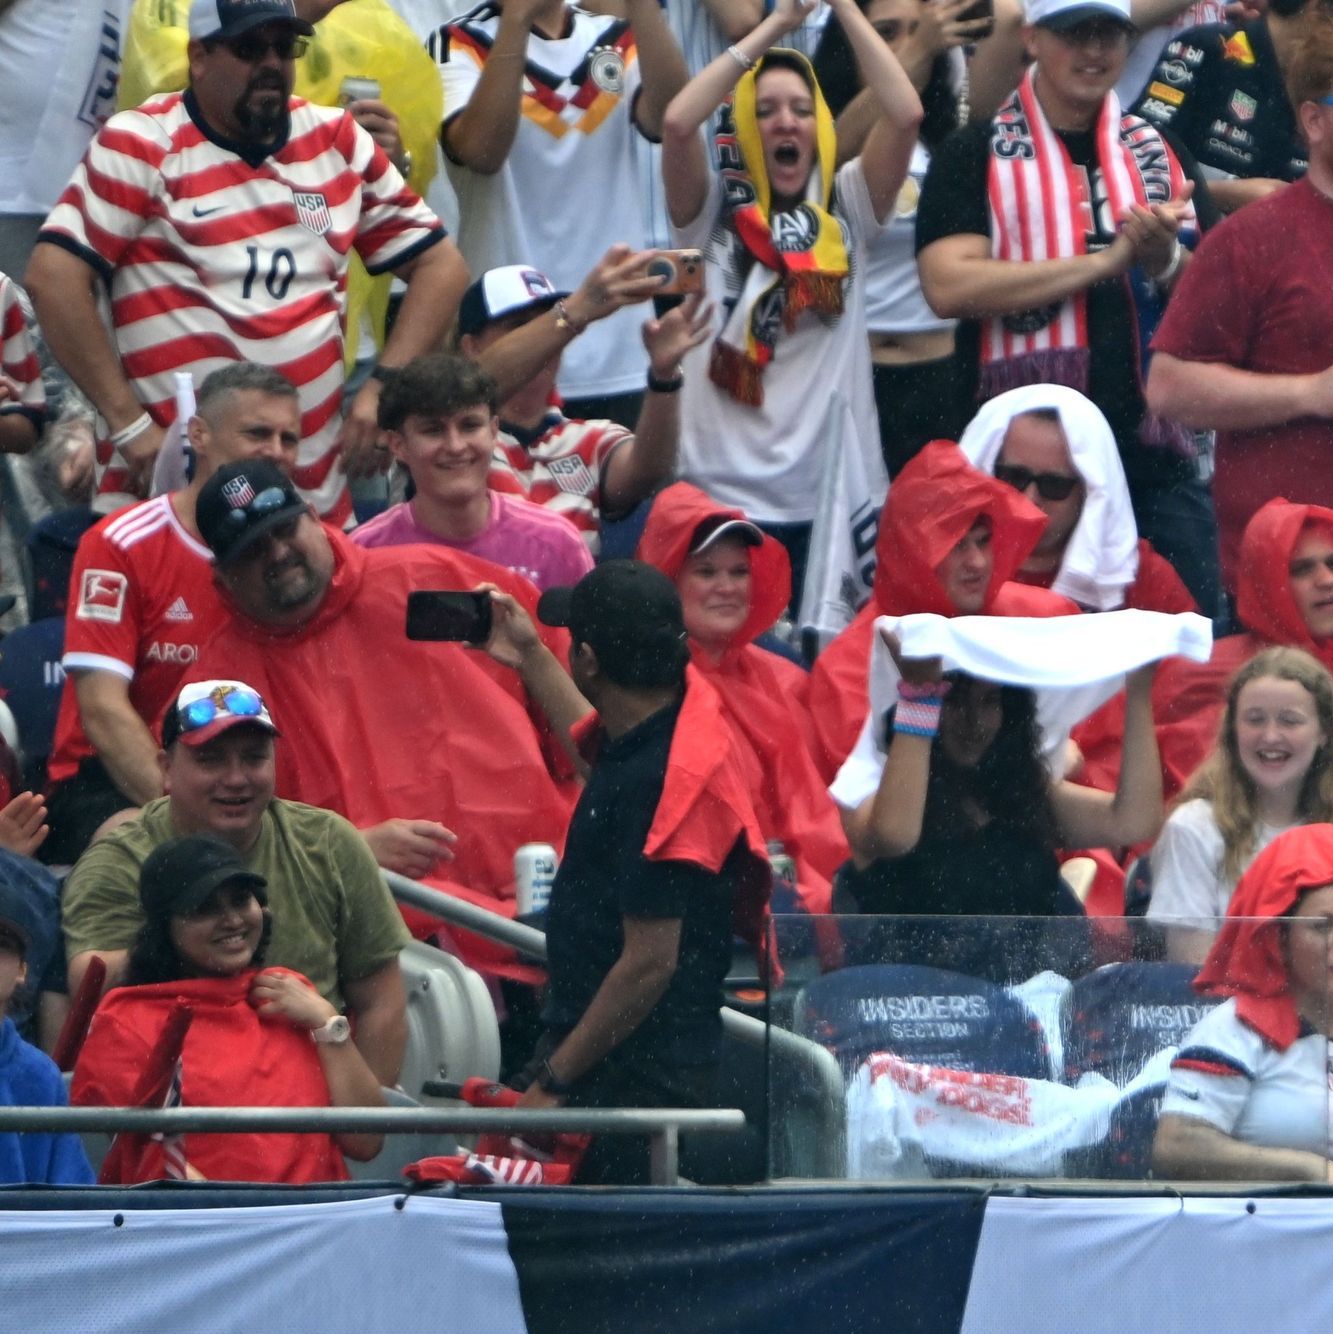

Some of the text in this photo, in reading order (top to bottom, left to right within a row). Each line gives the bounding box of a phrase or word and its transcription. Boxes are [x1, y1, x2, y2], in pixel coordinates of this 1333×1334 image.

[1209, 138, 1253, 162] ORACLE
[296, 194, 325, 212] USA
[242, 246, 298, 300] 10
[552, 457, 582, 476] USA
[223, 475, 250, 495] USA
[858, 995, 989, 1021] INSIDERS
[1131, 1004, 1207, 1028] INSID
[891, 1022, 969, 1039] SECTION
